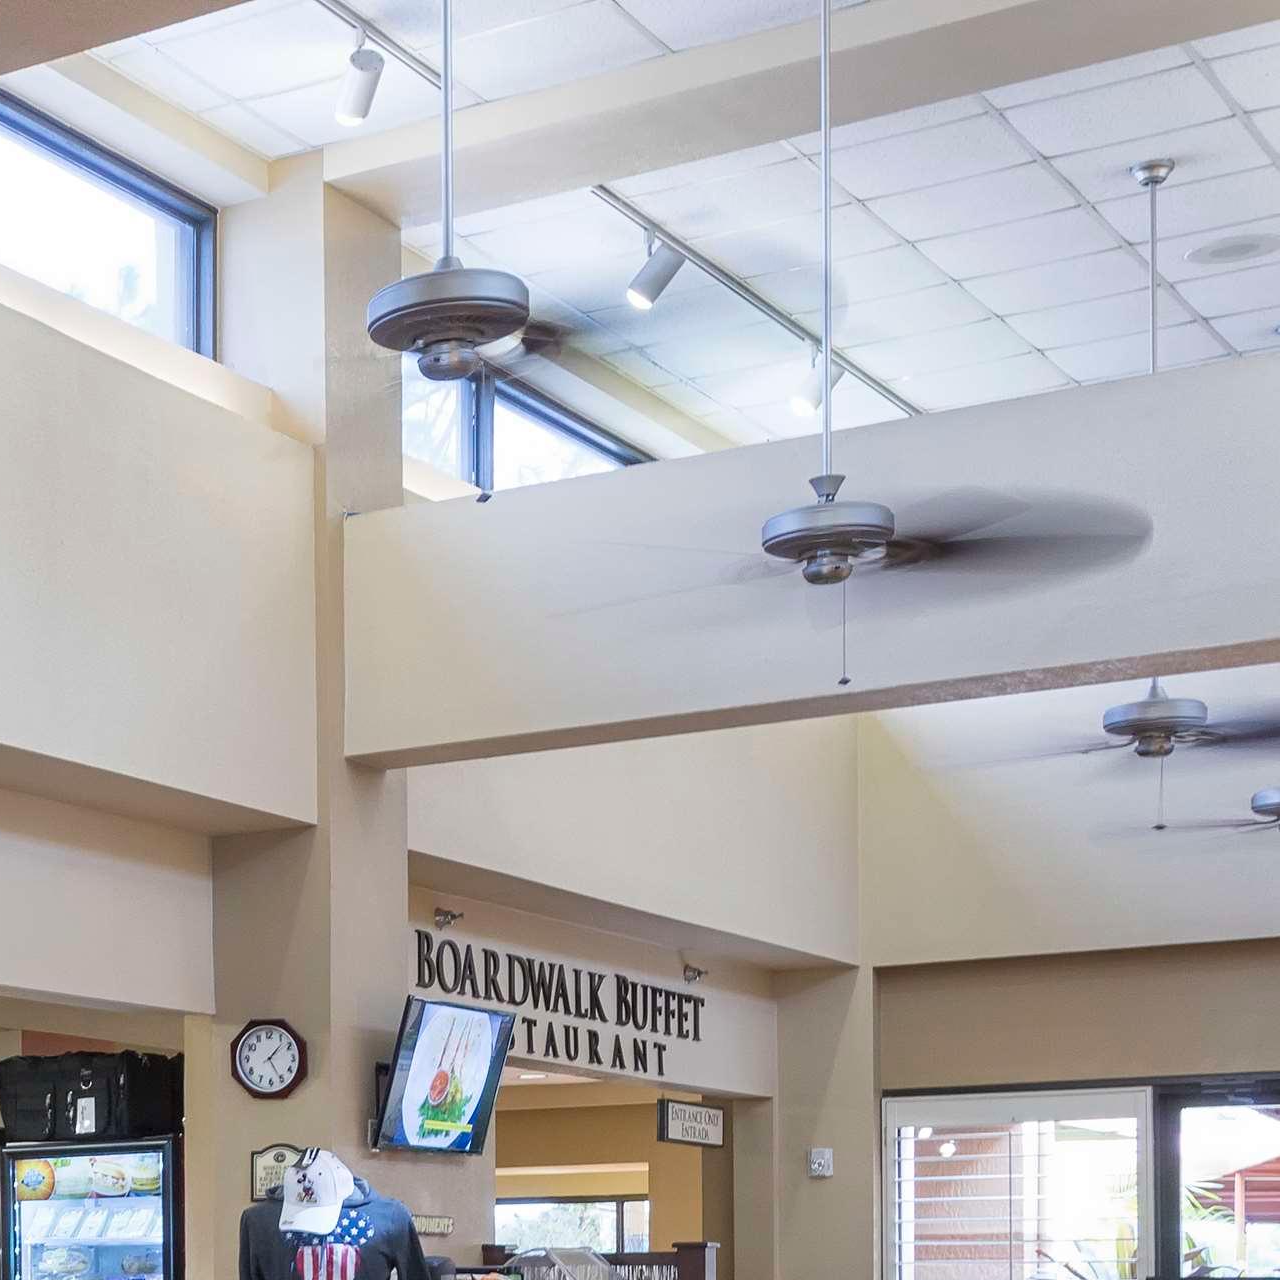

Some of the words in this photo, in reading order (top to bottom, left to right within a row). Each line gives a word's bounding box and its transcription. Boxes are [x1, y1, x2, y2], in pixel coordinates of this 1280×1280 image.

[415, 929, 609, 1024] BOARDWALK
[614, 973, 706, 1042] BUFFET
[510, 1015, 667, 1077] TAURANT
